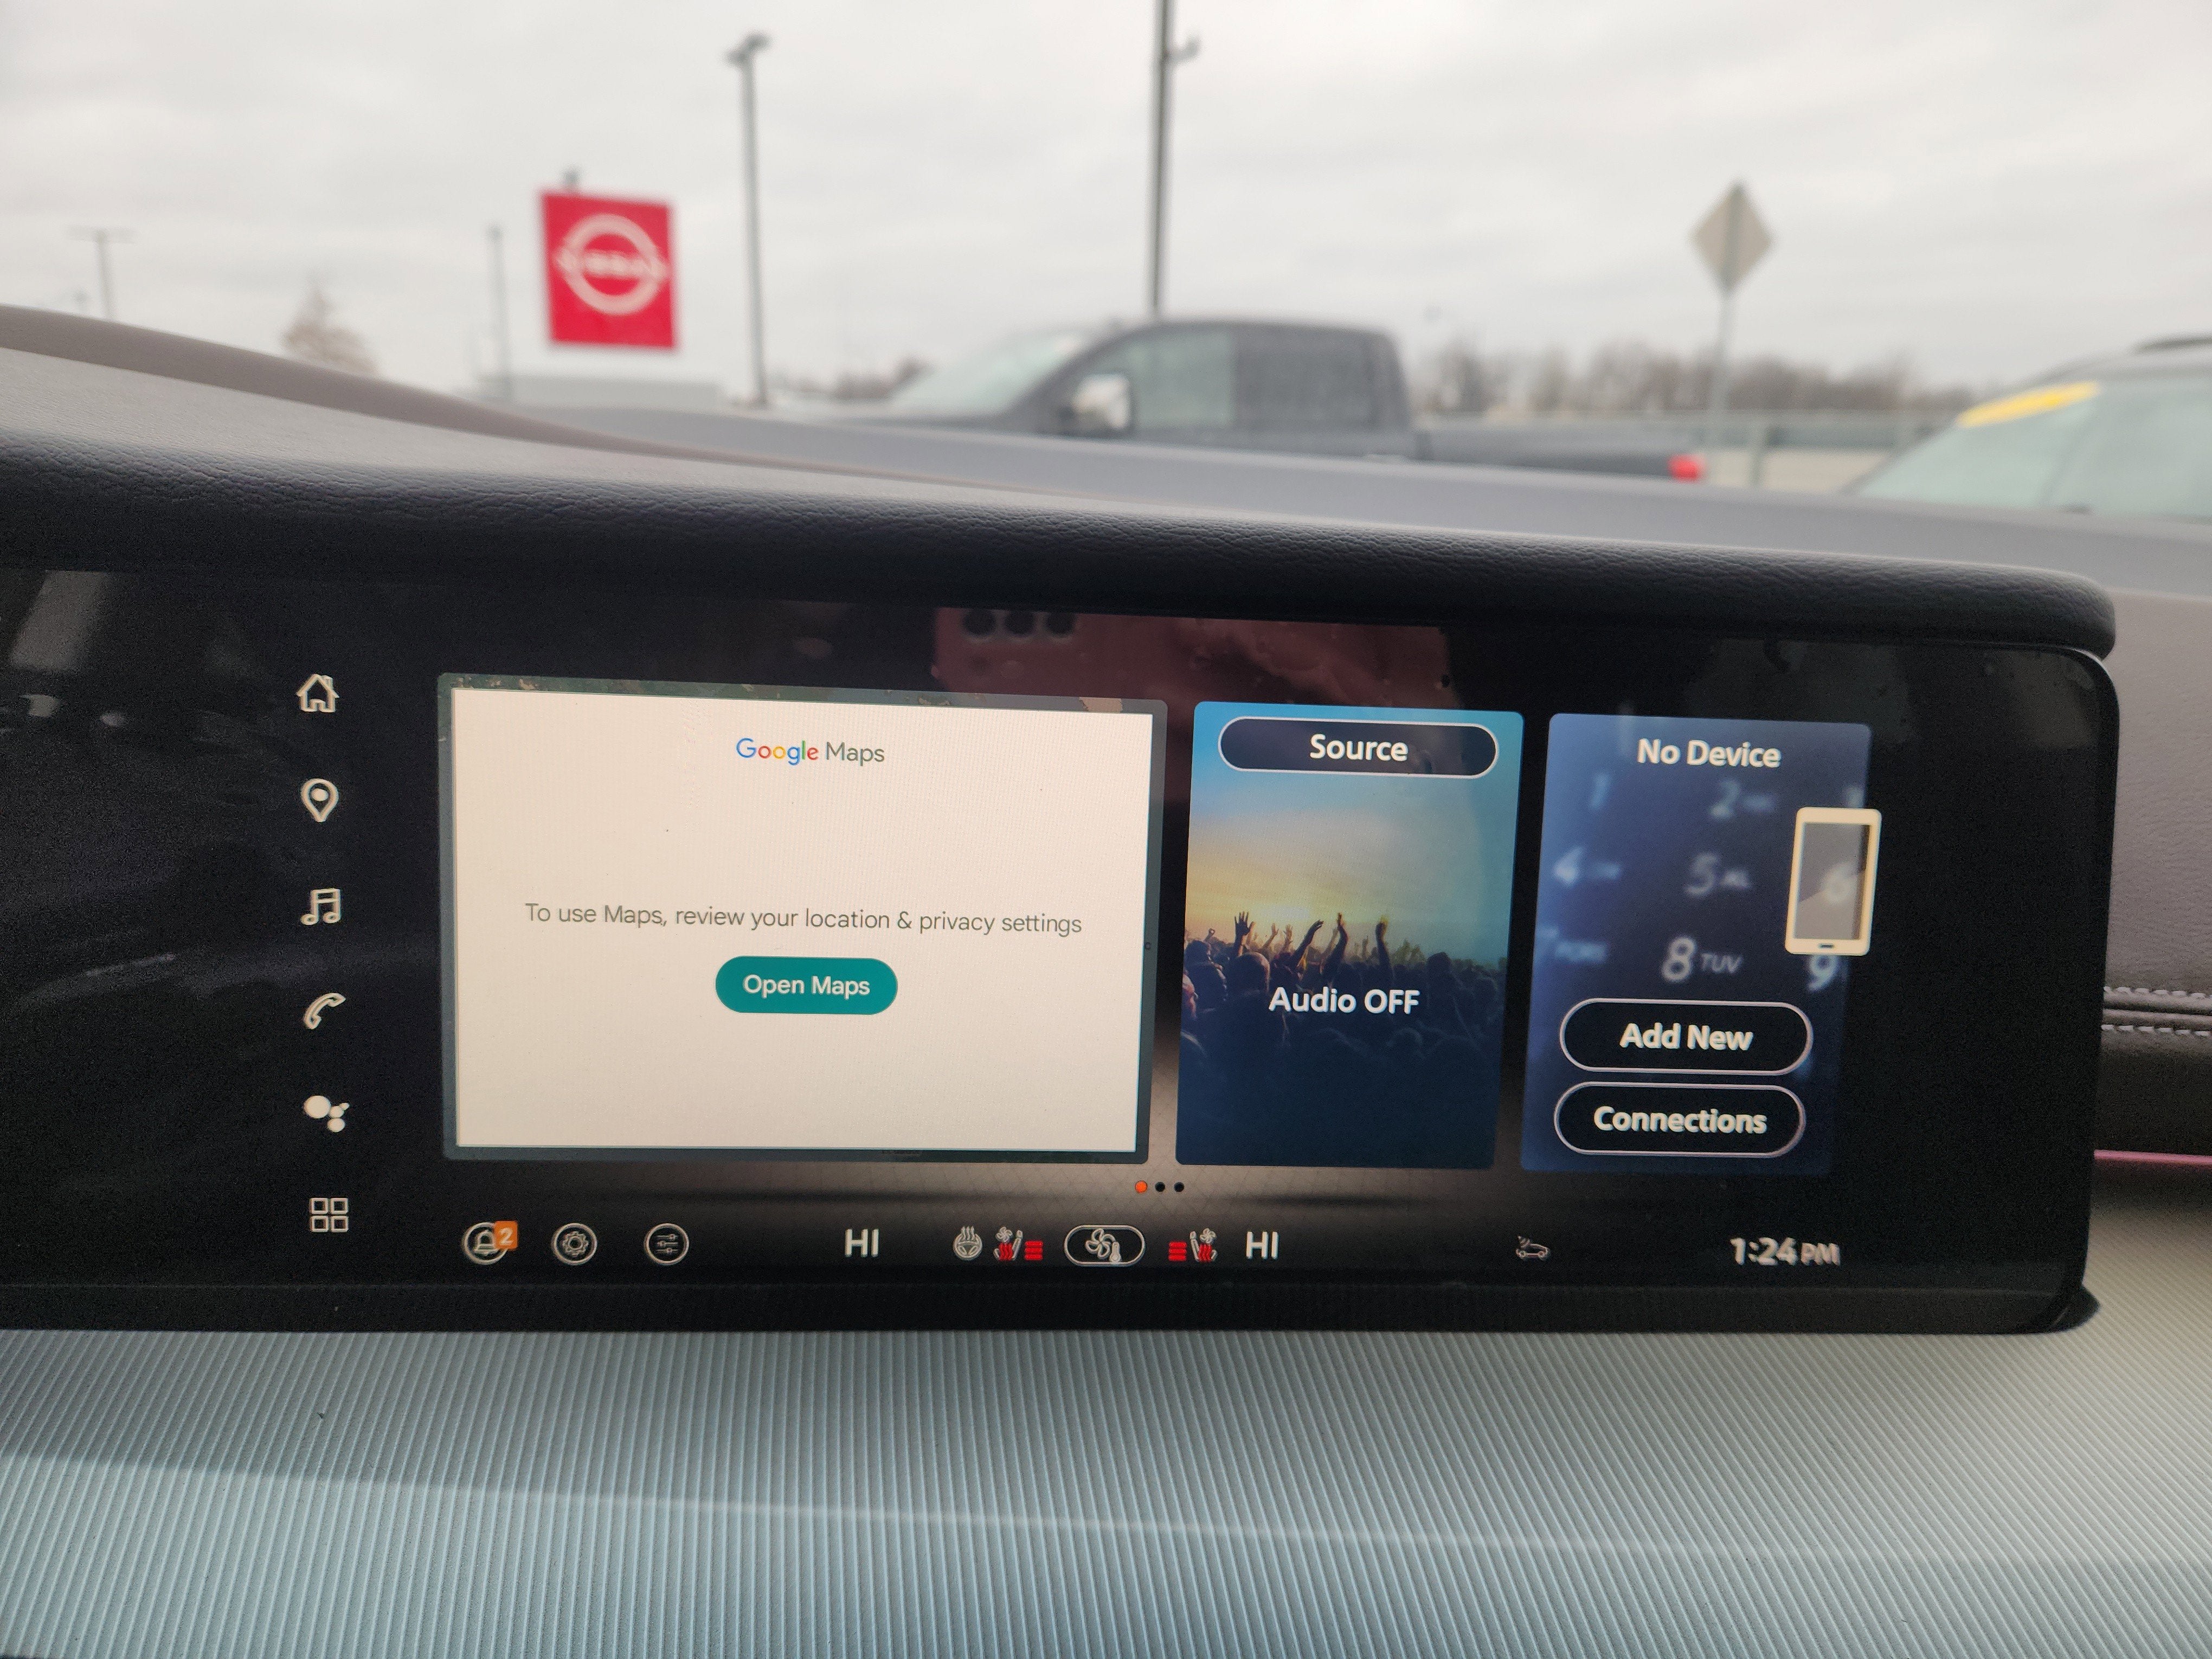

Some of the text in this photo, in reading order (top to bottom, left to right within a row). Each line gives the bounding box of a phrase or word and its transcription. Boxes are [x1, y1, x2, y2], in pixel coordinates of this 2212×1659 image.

[736, 737, 885, 767] Google Maps
[1310, 733, 1409, 762] Source
[1637, 738, 1782, 768] No Device
[525, 903, 1082, 937] To use Maps, review your location & privacy settings
[1661, 936, 1742, 982] 8 TUV
[743, 974, 871, 1000] Open Maps
[1268, 986, 1420, 1014] Audio OFF
[1619, 1022, 1754, 1051] Add New
[1593, 1105, 1767, 1134] Connections
[500, 1227, 513, 1246] 2
[845, 1229, 879, 1257] HI
[1246, 1231, 1279, 1259] HI
[1729, 1237, 1841, 1266] 1:24 PM
